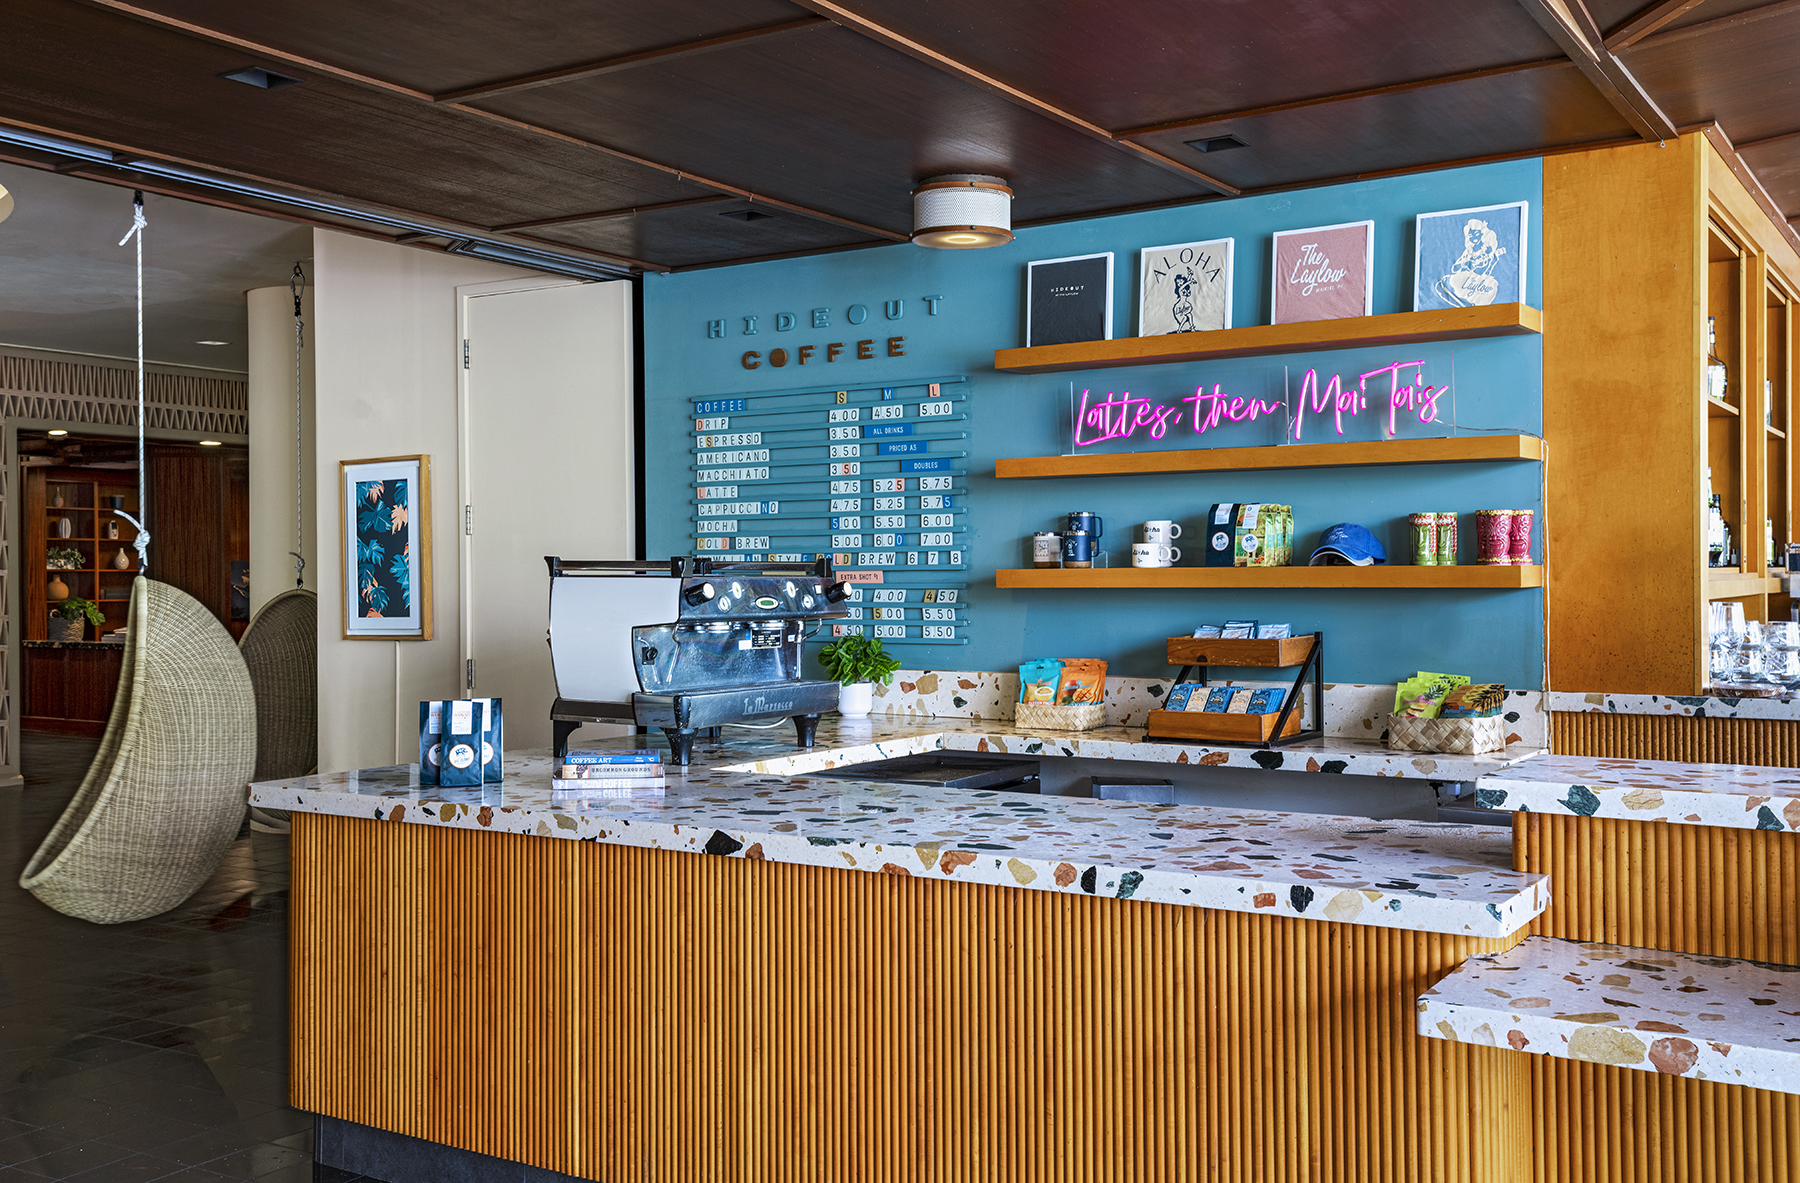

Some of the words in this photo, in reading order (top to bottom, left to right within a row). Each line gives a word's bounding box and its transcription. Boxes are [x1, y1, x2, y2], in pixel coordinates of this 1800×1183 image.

[1300, 242, 1326, 266] The
[1153, 247, 1221, 284] ALOHA
[1290, 258, 1347, 297] Laylow
[1461, 276, 1494, 297] Laylow
[707, 294, 944, 340] HIDEOUT
[741, 335, 906, 370] COFFEE
[697, 400, 742, 414] COFFEE
[838, 392, 845, 404] S
[884, 389, 892, 400] M
[931, 386, 937, 396] L
[1075, 388, 1183, 446] Lattes,
[1181, 382, 1281, 434] then
[1294, 367, 1367, 441] Mai
[1359, 359, 1450, 436] Tais
[697, 418, 727, 431] DRIP
[830, 410, 858, 421] 4.00
[874, 406, 901, 419] 4.50
[921, 403, 950, 416] 5.00
[698, 433, 760, 448] ESPRESSO
[830, 427, 858, 439] 3.50
[872, 427, 883, 435] ALL
[884, 426, 904, 434] DRINKS
[698, 450, 768, 464] AMERICANO
[831, 446, 858, 457] 3.50
[888, 444, 908, 452] PRICED
[698, 468, 767, 481] MACCHIATO
[831, 464, 858, 475] 3.50
[913, 461, 939, 469] DOUBLES
[698, 486, 735, 499] LATTE
[831, 481, 859, 493] 4.75
[875, 480, 903, 491] 5.25
[921, 477, 950, 490] 5.75
[699, 502, 777, 515] CAPPUCCINO
[832, 499, 859, 510] 4.75
[875, 498, 903, 509] 5.25
[922, 496, 951, 508] 5.75
[698, 521, 736, 532] MOCHA
[832, 517, 858, 529] 5.00
[875, 516, 903, 528] 5.50
[922, 515, 951, 527] 6.00
[698, 538, 728, 549] COLD
[737, 537, 768, 549] BREW
[833, 536, 860, 547] 5.00
[875, 535, 903, 546] 6.00
[922, 533, 951, 545] 7.00
[860, 553, 895, 564] BREW
[909, 553, 916, 564] 6
[930, 553, 936, 564] 7
[952, 552, 959, 563] 8
[840, 573, 857, 581] EXTRA
[875, 591, 904, 601] 4.00
[874, 608, 902, 619] 5.00
[924, 609, 953, 620] 5.50
[876, 626, 903, 637] 5.00
[924, 626, 953, 637] 5.50
[603, 779, 632, 788] COFFEE
